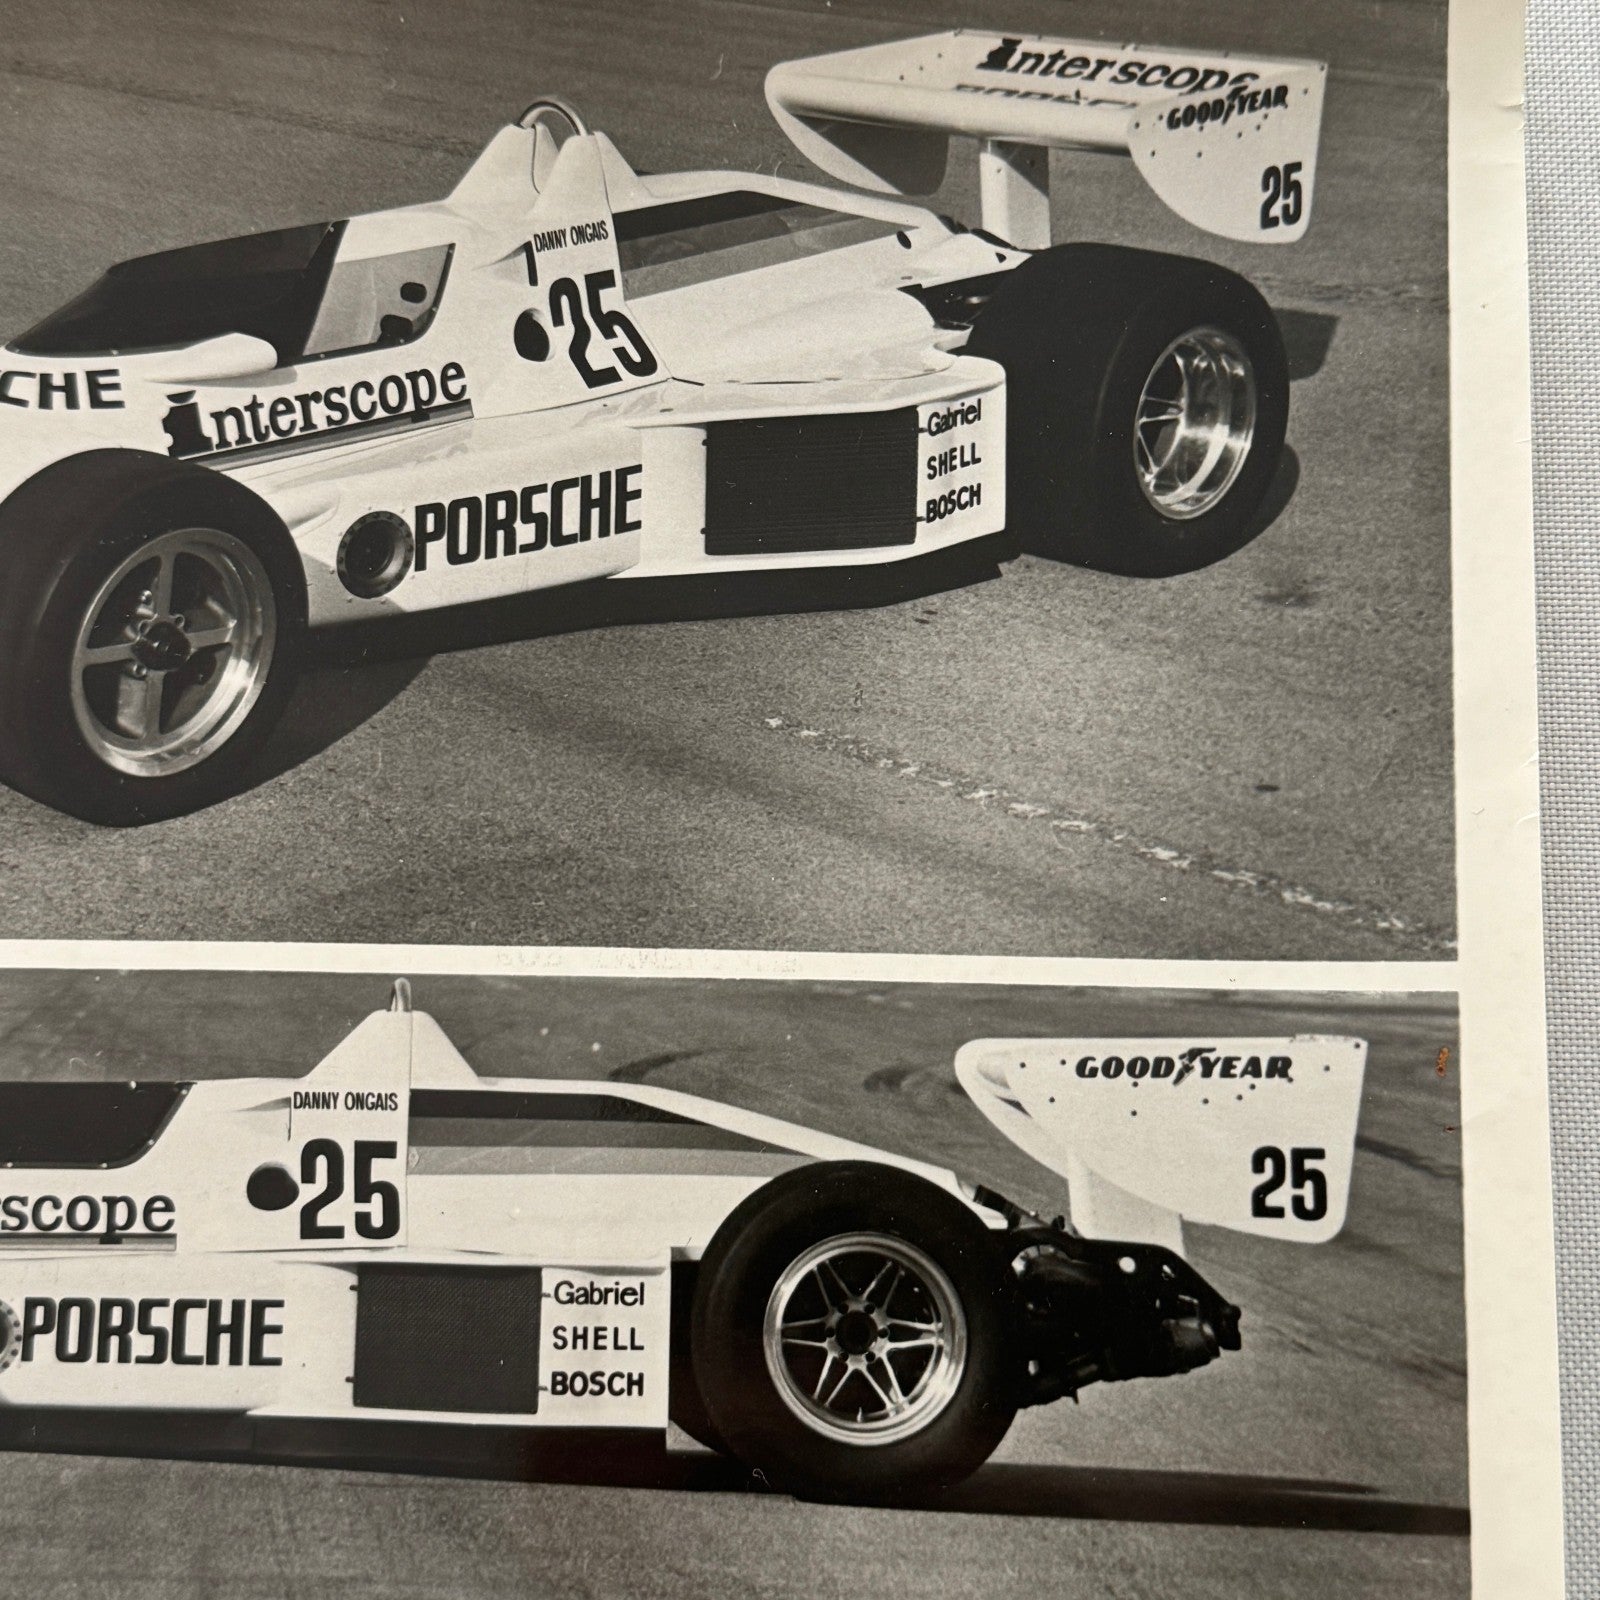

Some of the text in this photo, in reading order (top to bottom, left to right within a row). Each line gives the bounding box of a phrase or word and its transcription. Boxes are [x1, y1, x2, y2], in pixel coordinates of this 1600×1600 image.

[1166, 85, 1289, 130] GOODYEAR
[1260, 162, 1303, 230] 25
[533, 219, 609, 253] DANNY ONGAIS
[548, 268, 658, 389] 25
[926, 398, 982, 437] Gabriel
[926, 442, 982, 481] SHELL
[411, 463, 643, 573] PORSCHE
[925, 482, 982, 524] BOSCH
[1075, 1047, 1294, 1086] GOODYEAR
[293, 1091, 399, 1112] DANNY ONGAIS
[299, 1138, 401, 1240] 25
[1251, 1145, 1328, 1222] 25
[553, 1280, 645, 1307] Gabriel
[18, 1297, 285, 1367] PORSCHE
[552, 1325, 645, 1352] SHELL
[550, 1370, 645, 1398] BOSCH
